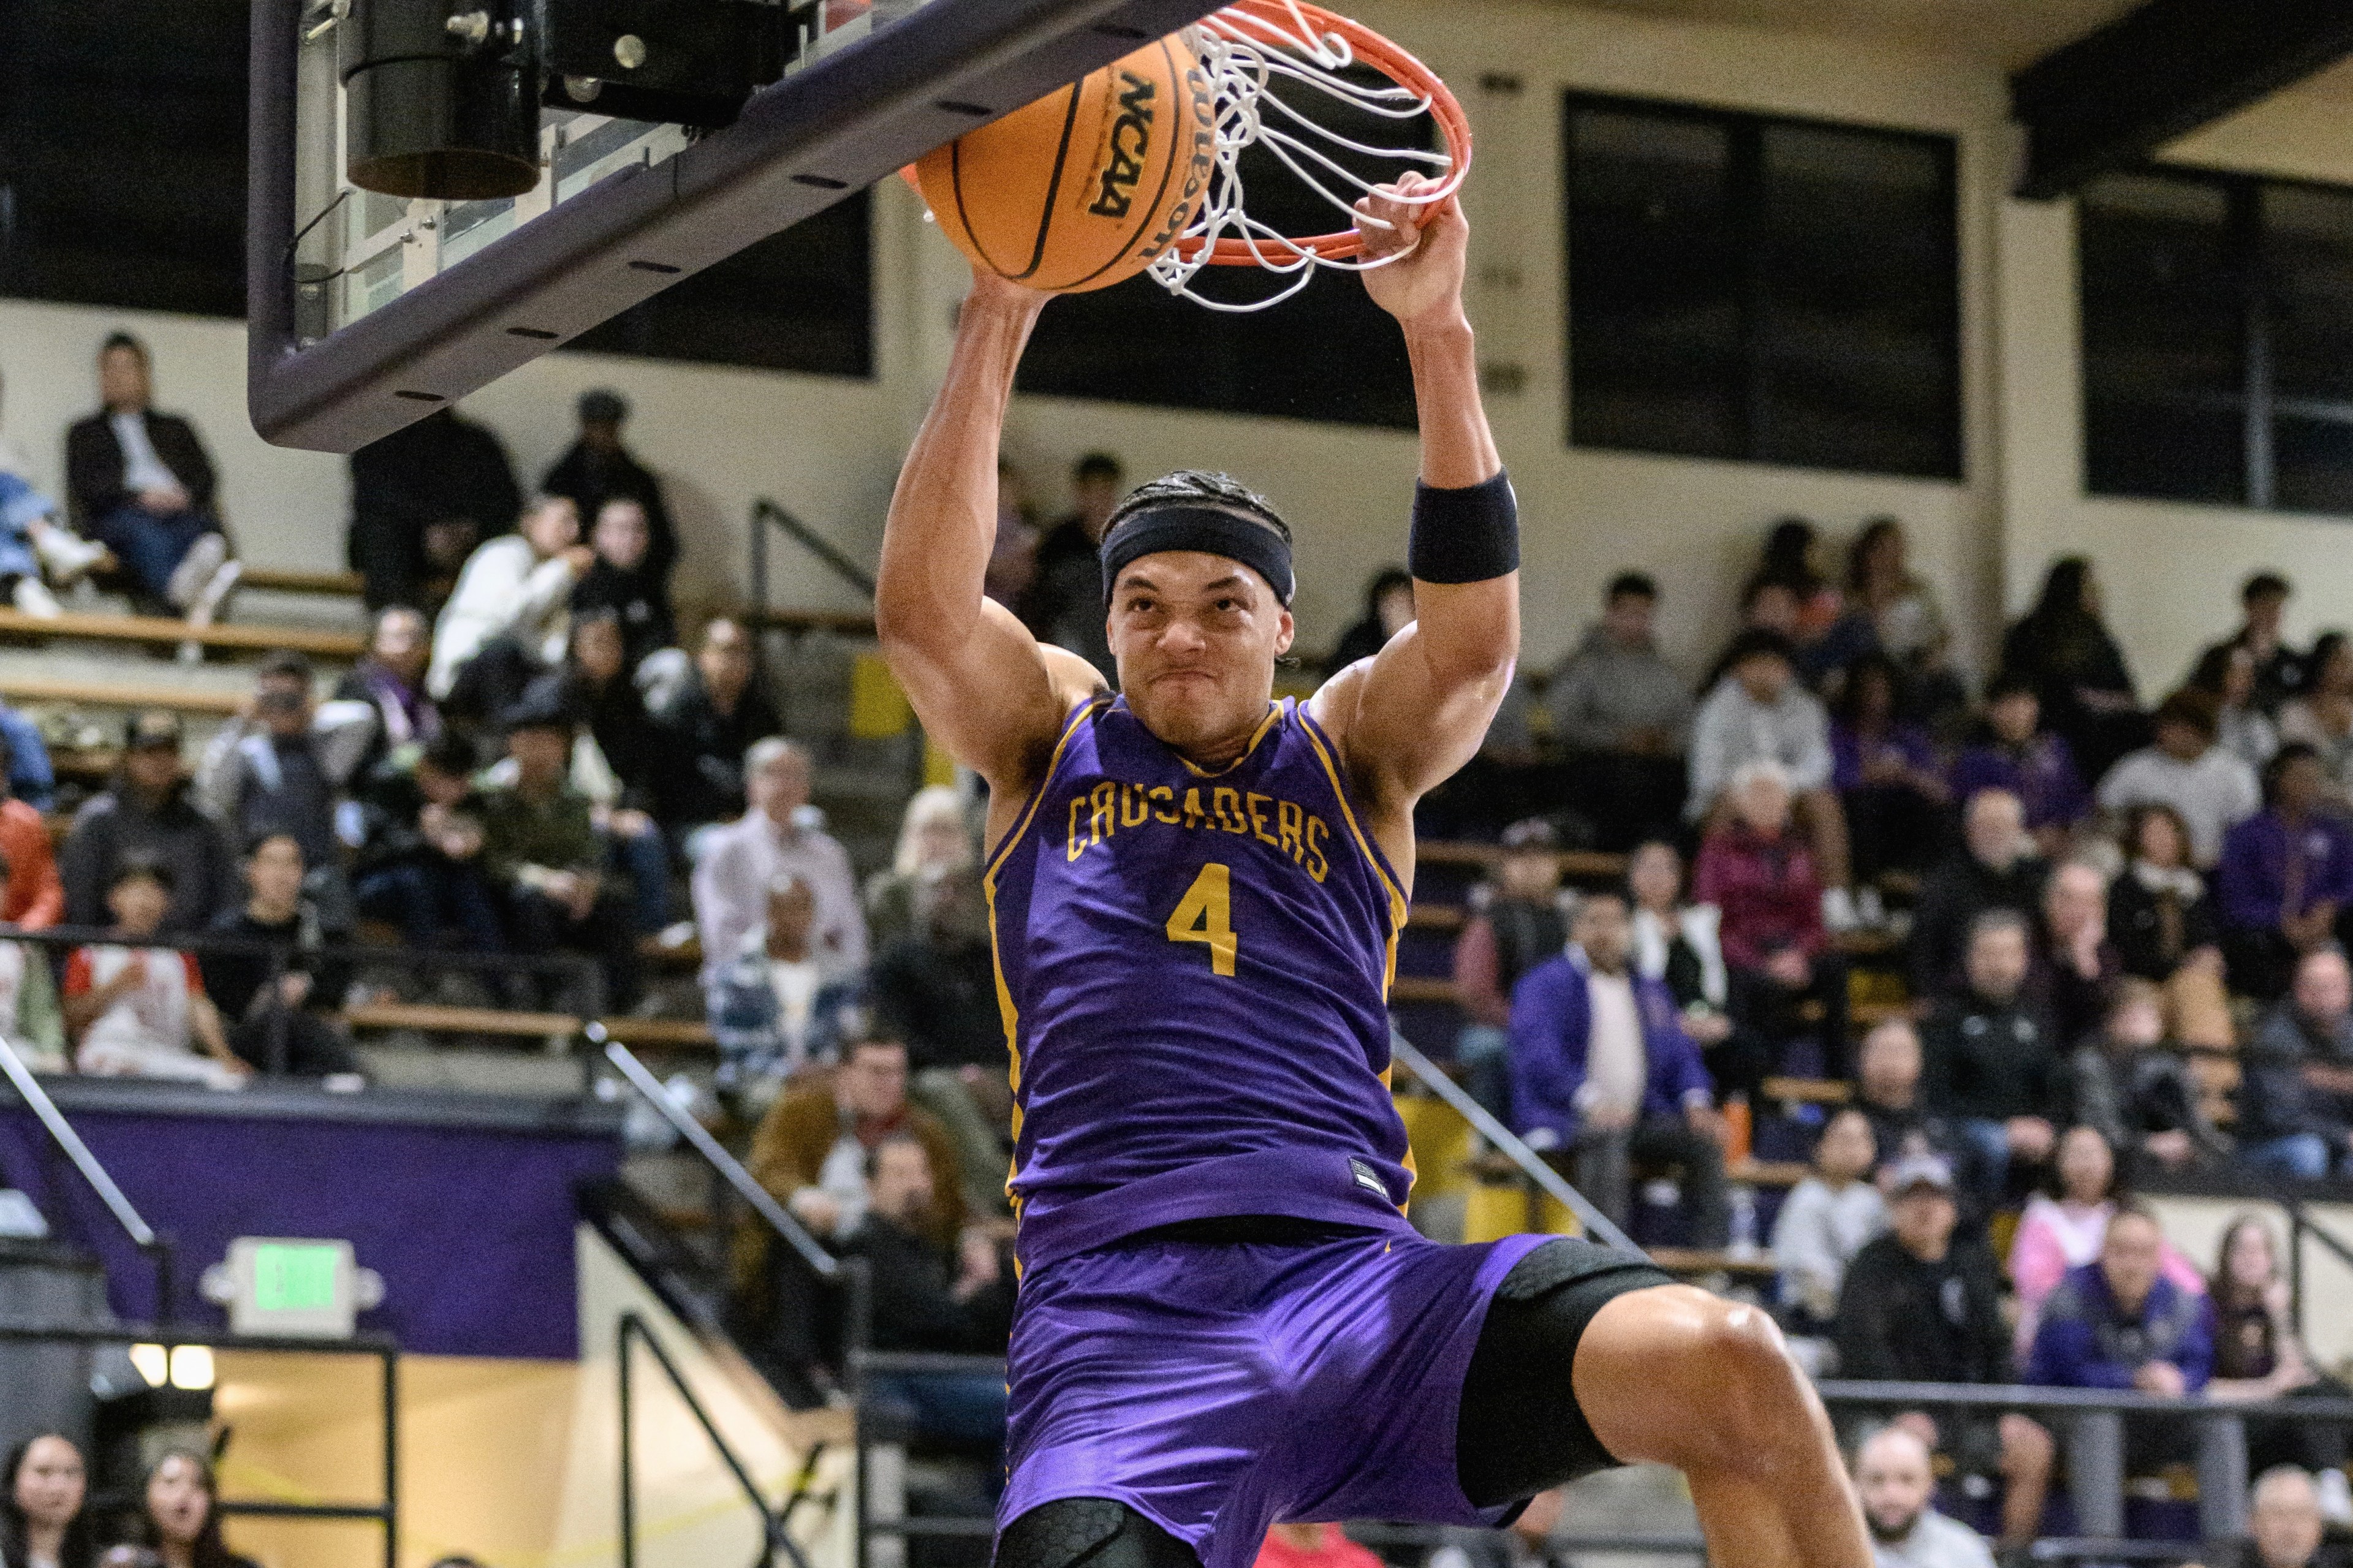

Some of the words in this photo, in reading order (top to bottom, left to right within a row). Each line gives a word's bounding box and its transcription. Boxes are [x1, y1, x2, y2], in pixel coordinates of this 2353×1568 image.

[1088, 70, 1154, 219] NCAA
[1067, 781, 1329, 883] CRUSADERS
[1166, 863, 1237, 977] 4
